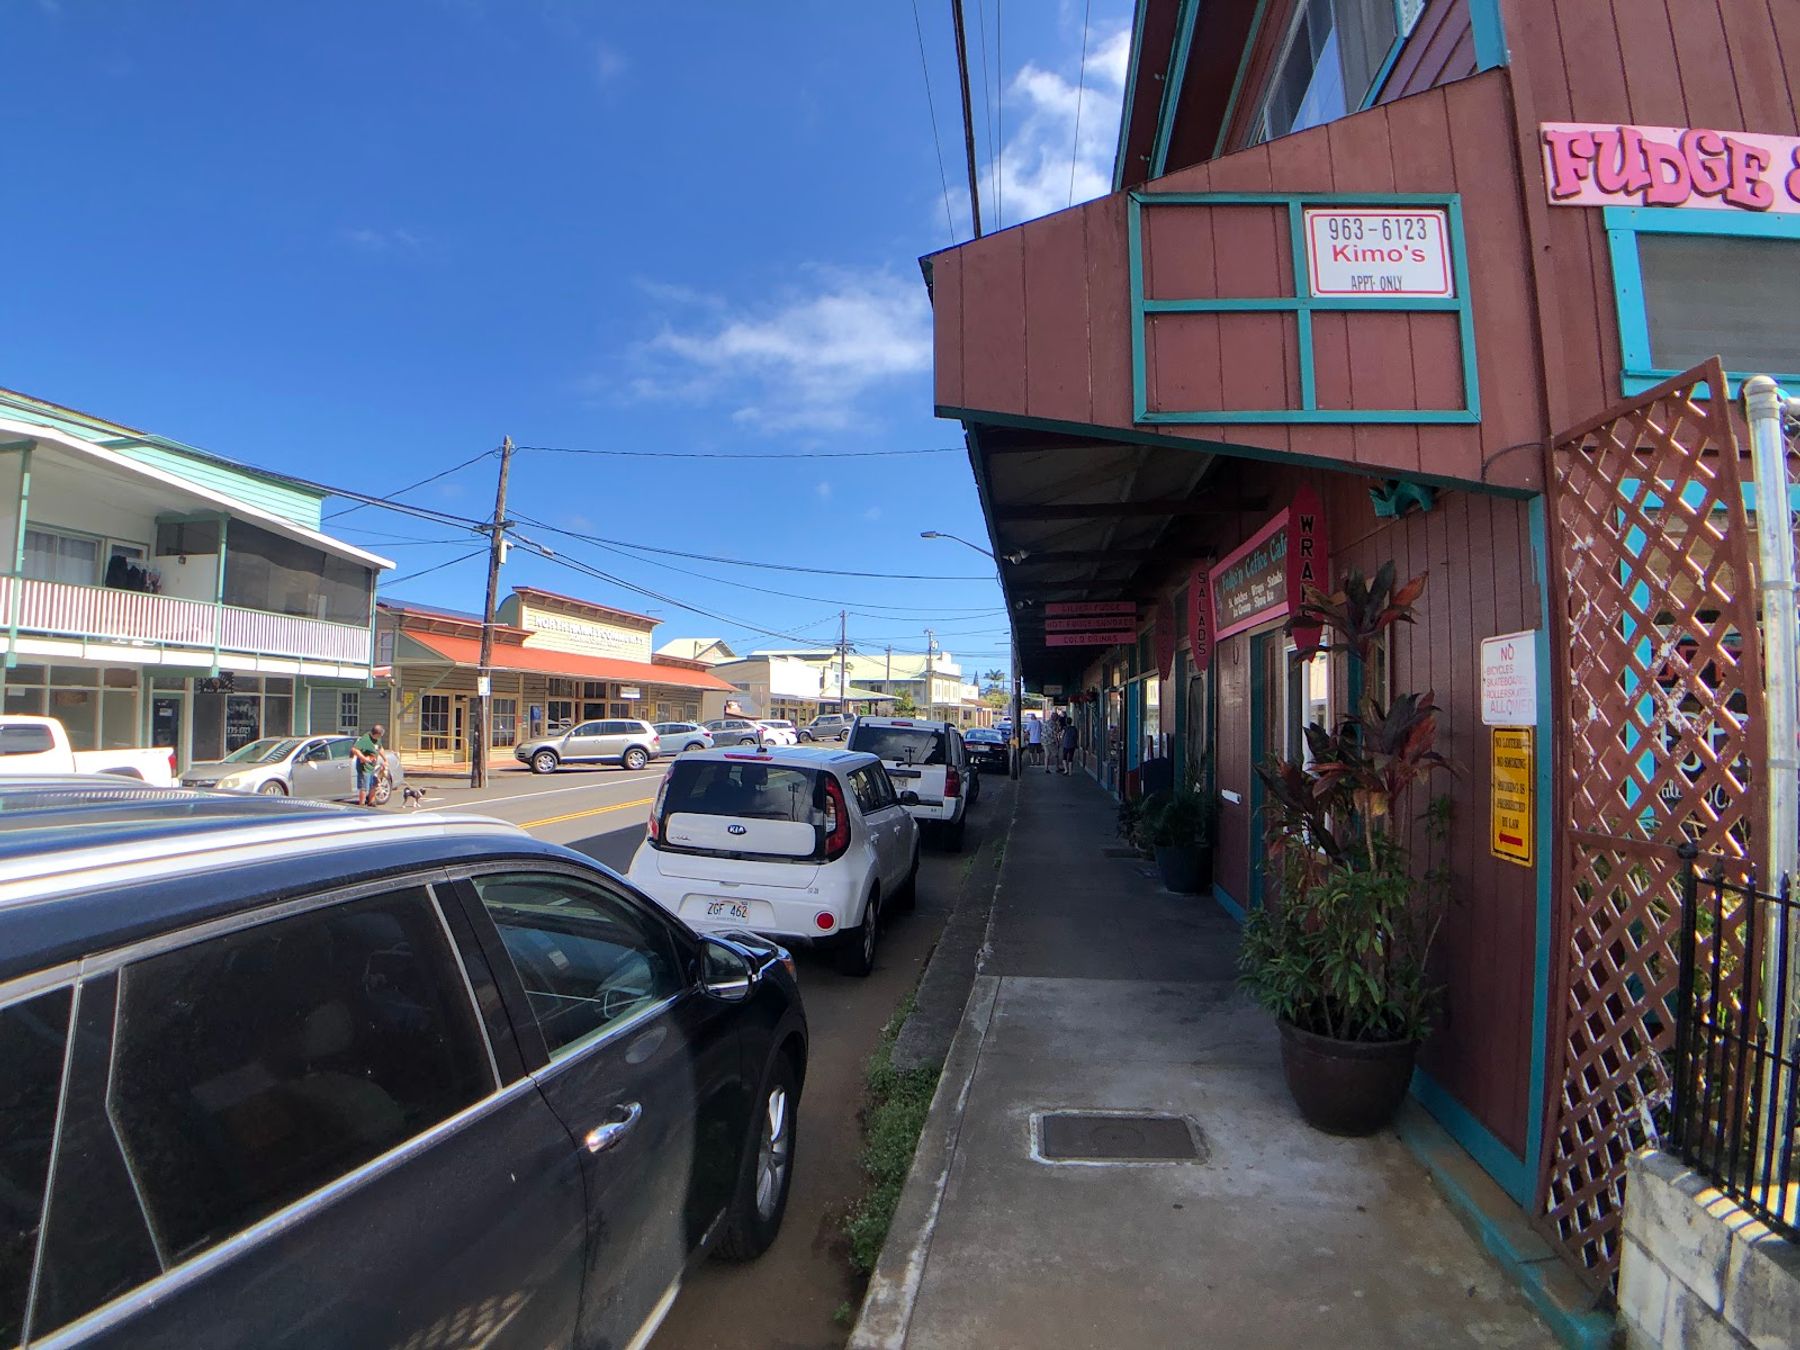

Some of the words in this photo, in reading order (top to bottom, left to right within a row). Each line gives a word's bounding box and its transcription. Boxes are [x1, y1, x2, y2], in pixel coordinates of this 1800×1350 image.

[1544, 126, 1774, 211] FUDGE
[1328, 217, 1427, 241] 963-6123
[1331, 244, 1426, 263] Kimo's
[1380, 275, 1403, 291] ONLY
[1299, 515, 1315, 618] WRA
[1198, 572, 1209, 655] SALADS
[1500, 646, 1514, 662] NO
[1486, 664, 1514, 676] BICYCLES
[729, 826, 745, 834] KIA
[707, 902, 725, 915] ZGF
[730, 904, 748, 918] 462
